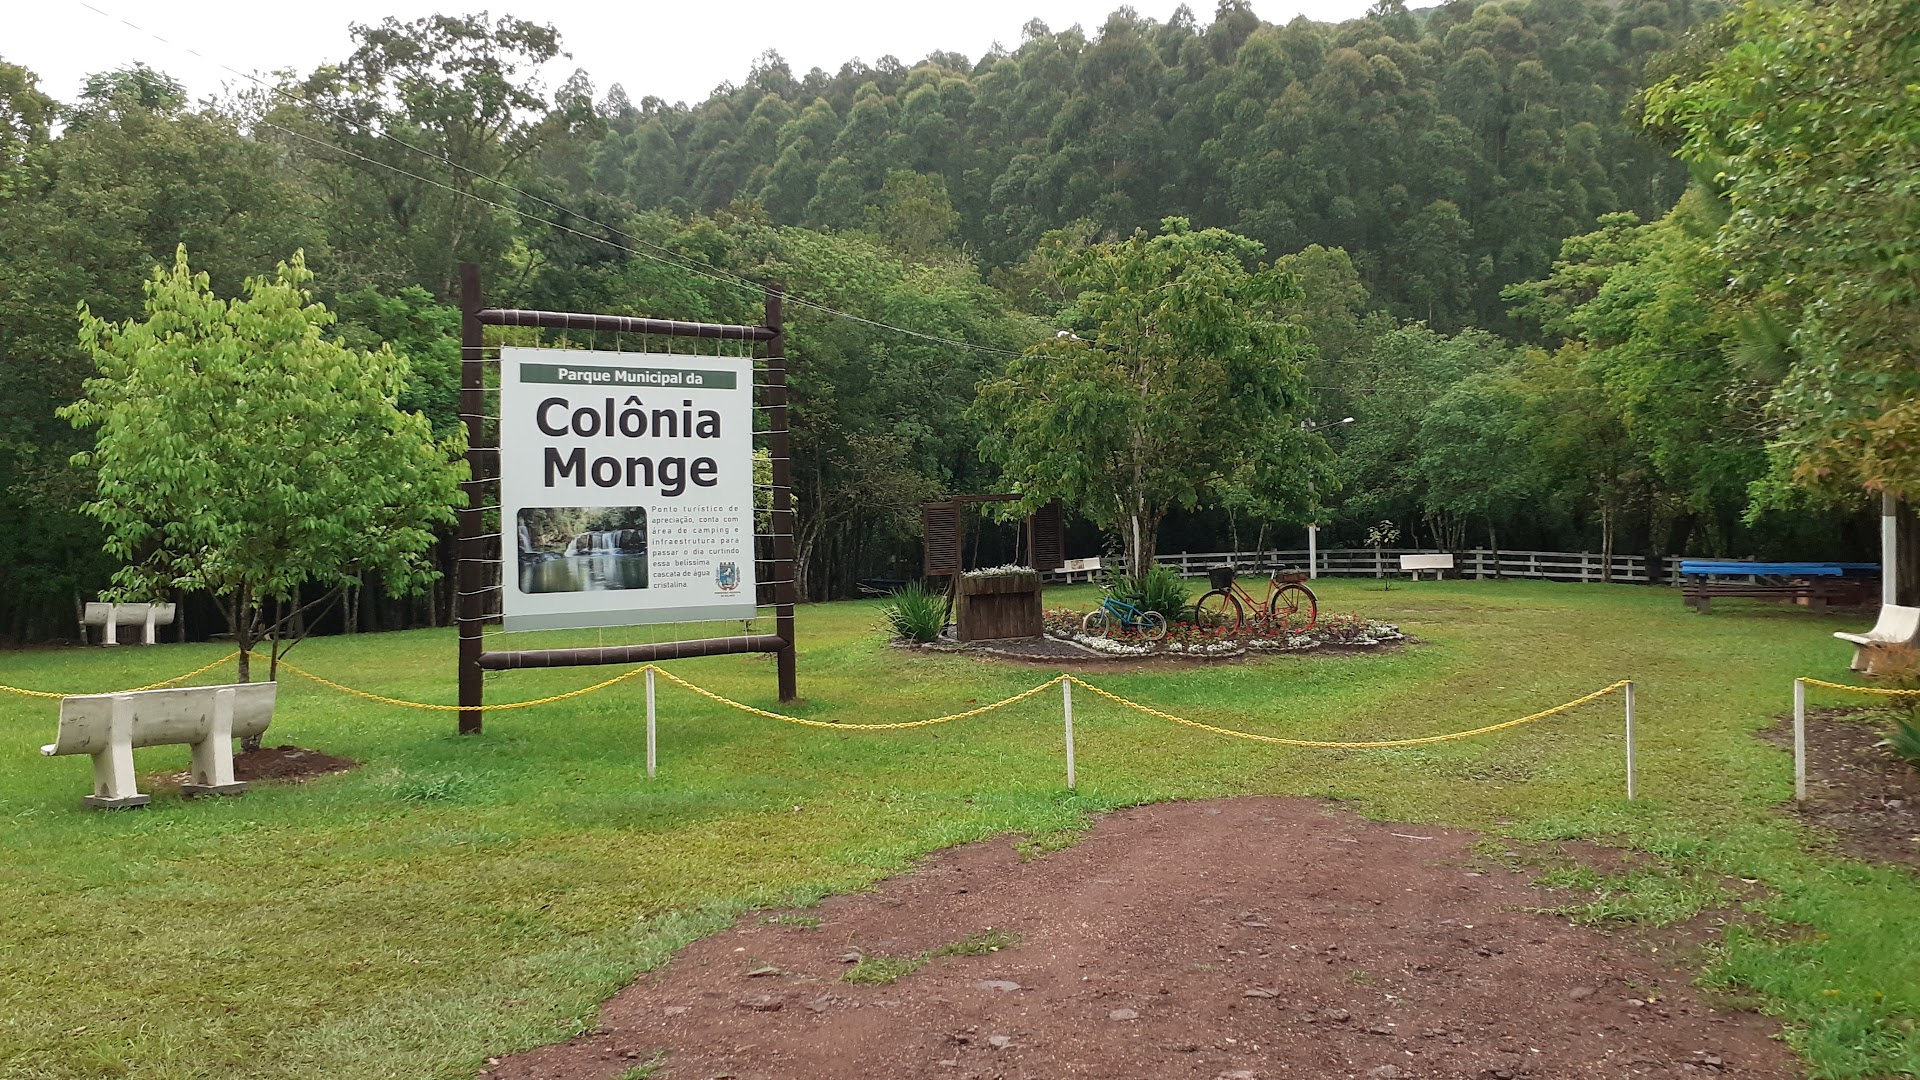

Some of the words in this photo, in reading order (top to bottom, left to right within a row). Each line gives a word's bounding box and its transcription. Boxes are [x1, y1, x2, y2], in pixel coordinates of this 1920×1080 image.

[558, 368, 611, 384] Parque
[614, 370, 683, 386] Municipal
[686, 374, 703, 385] da
[536, 395, 721, 439] Colônia
[544, 447, 718, 497] Monge
[651, 505, 678, 513] Ponto
[651, 516, 695, 524] apreciação,
[651, 527, 672, 535] área
[692, 526, 729, 535] camping
[652, 550, 679, 558] passar
[693, 569, 710, 577] água
